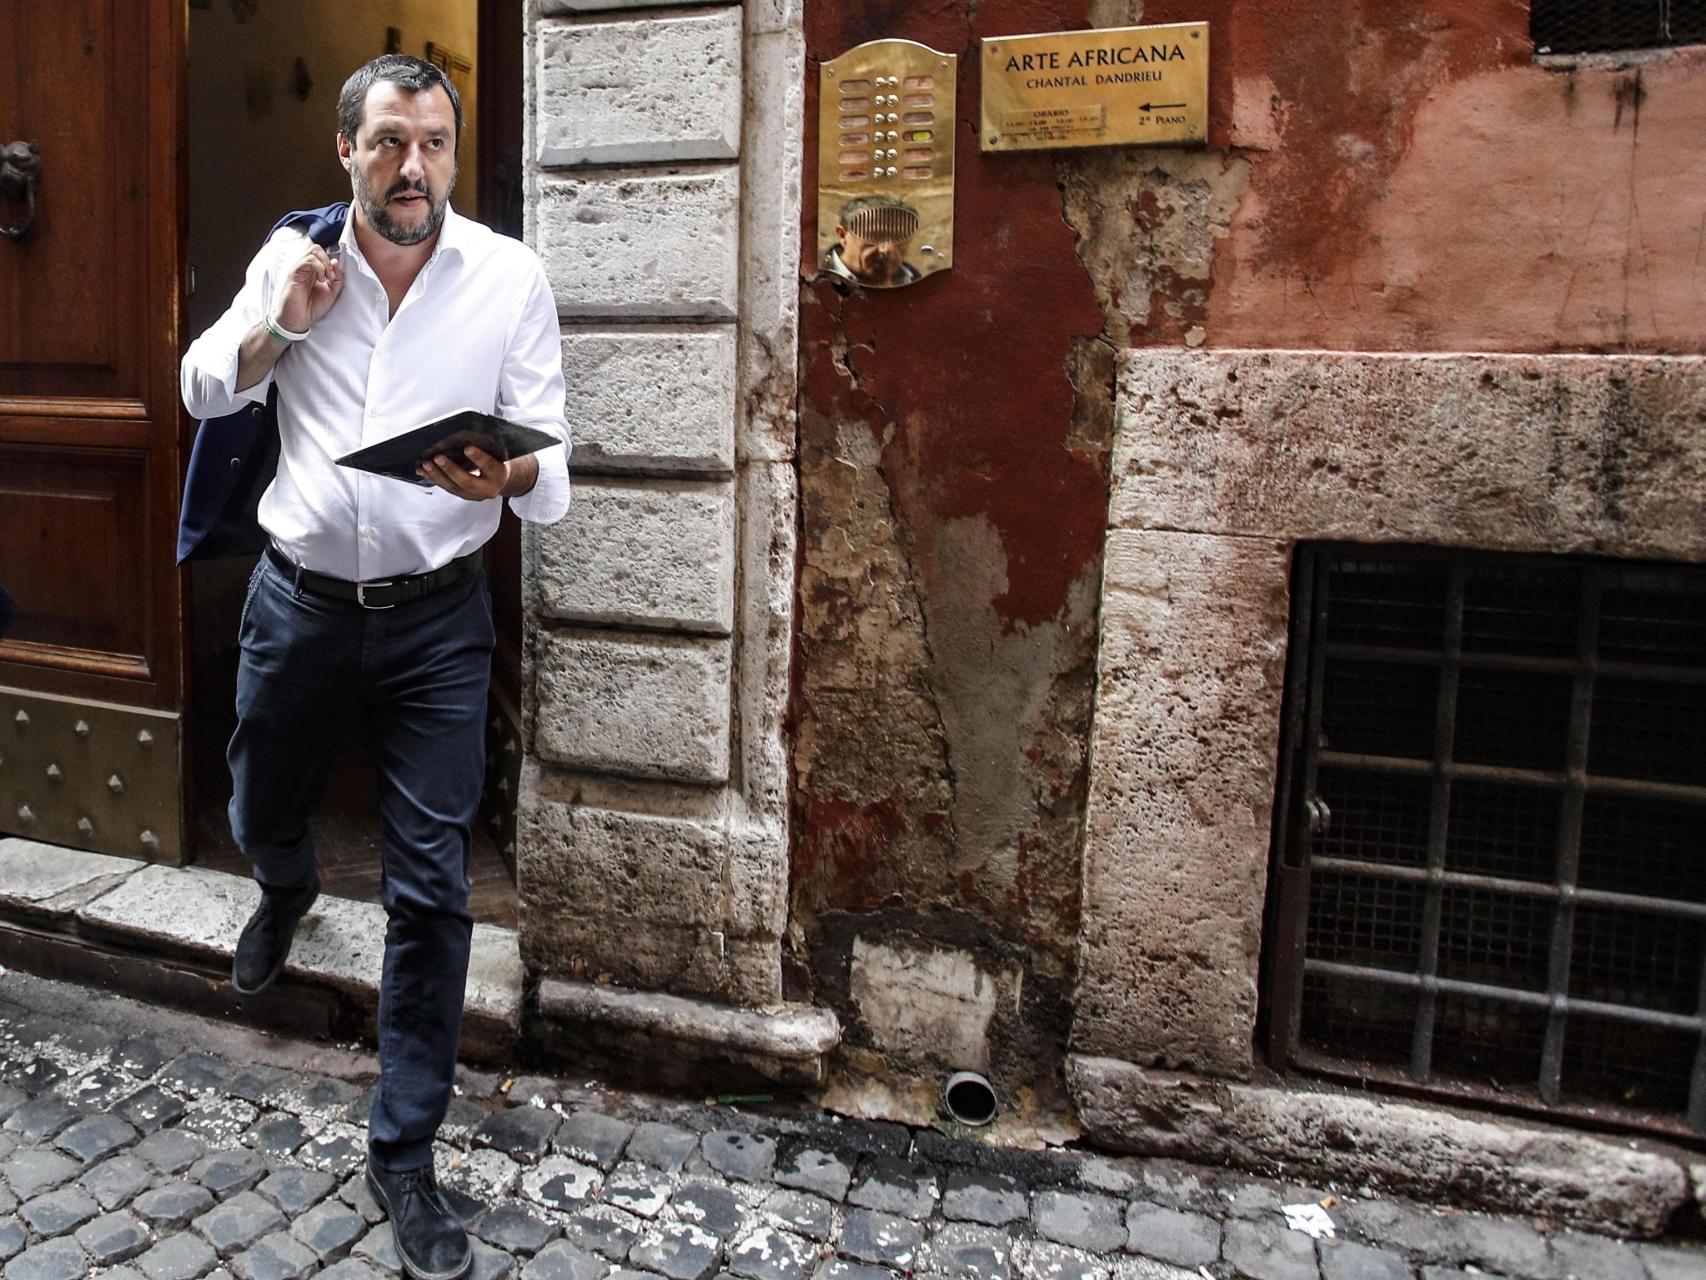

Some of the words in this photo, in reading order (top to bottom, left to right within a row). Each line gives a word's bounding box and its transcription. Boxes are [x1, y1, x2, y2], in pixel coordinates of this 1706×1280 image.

[1005, 52, 1059, 72] ARTE
[1068, 44, 1185, 68] AFRICANA
[1026, 75, 1087, 89] CHANTAL
[1095, 70, 1162, 85] DANDRIEU
[1034, 109, 1069, 118] ORARIO
[1156, 115, 1186, 125] PIANO
